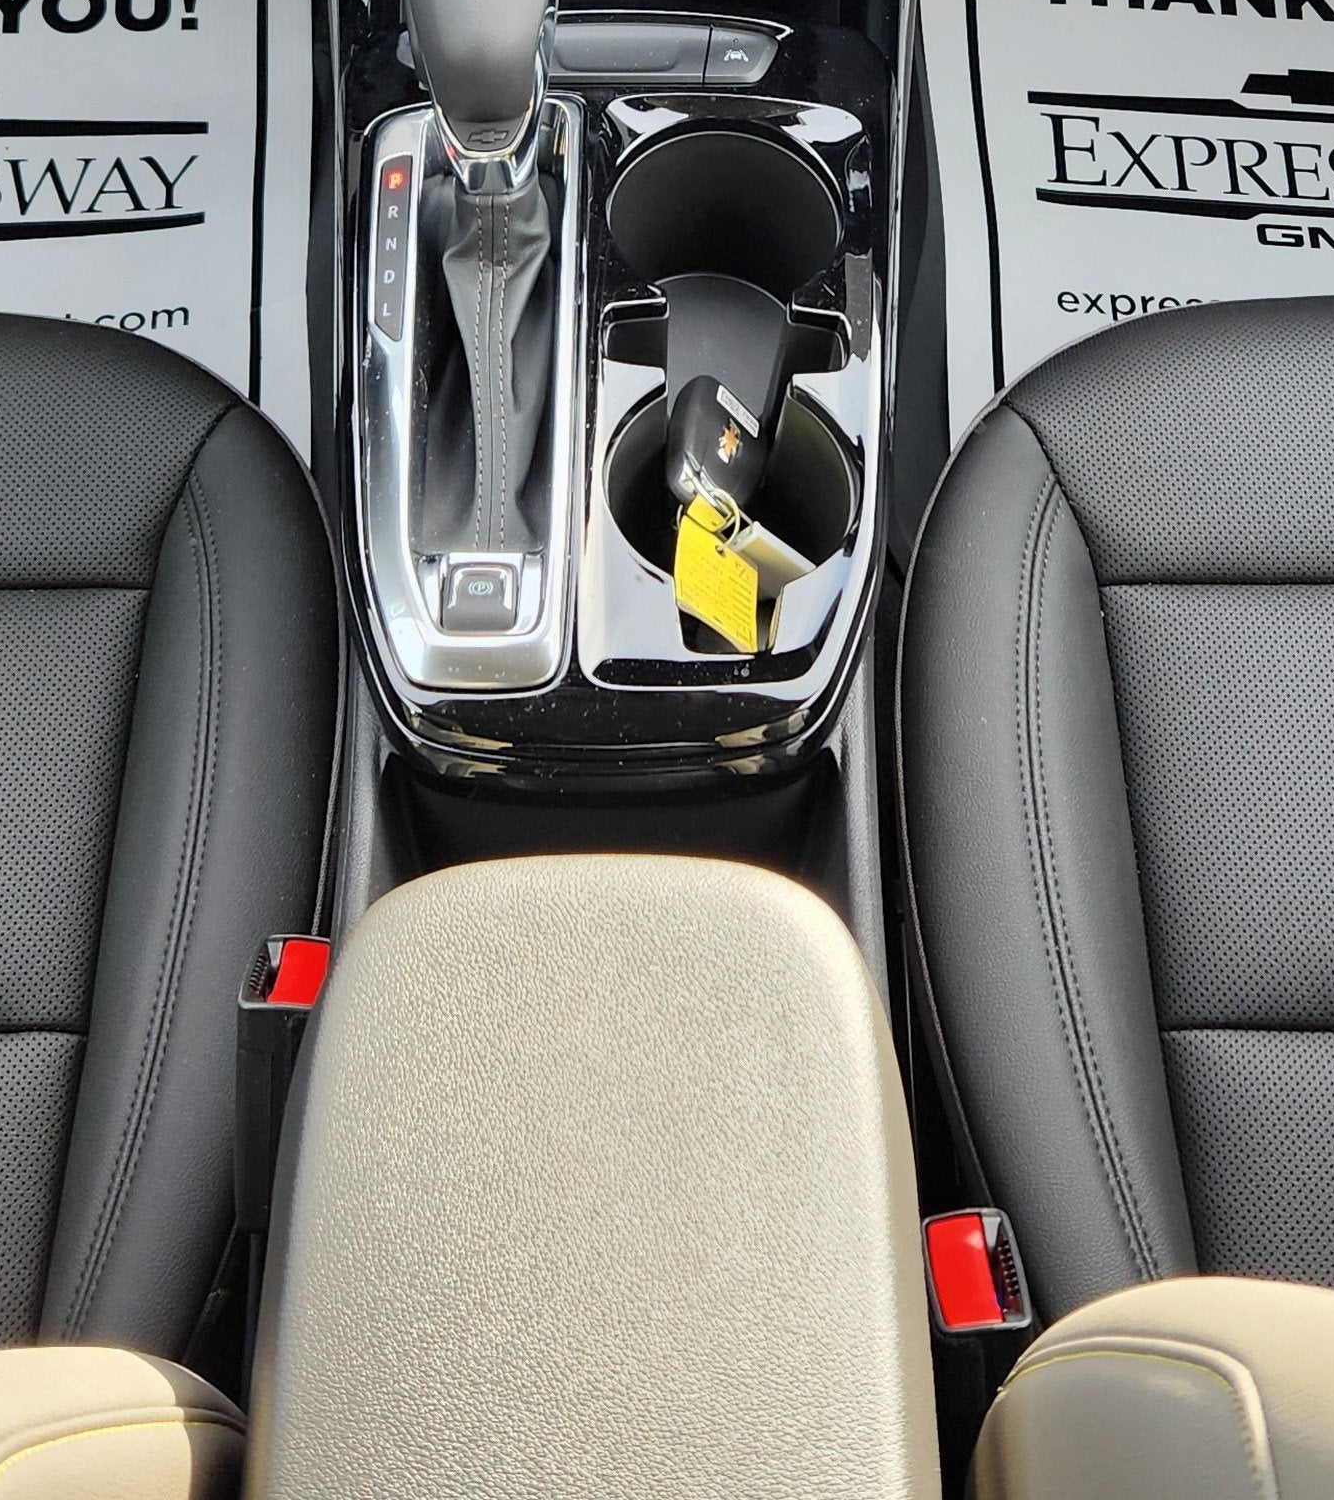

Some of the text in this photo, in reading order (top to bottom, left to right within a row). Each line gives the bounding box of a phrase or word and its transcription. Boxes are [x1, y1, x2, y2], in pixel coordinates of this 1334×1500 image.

[387, 172, 404, 190] P
[387, 205, 399, 220] R
[385, 237, 397, 251] N
[383, 269, 396, 284] D
[382, 302, 392, 318] L
